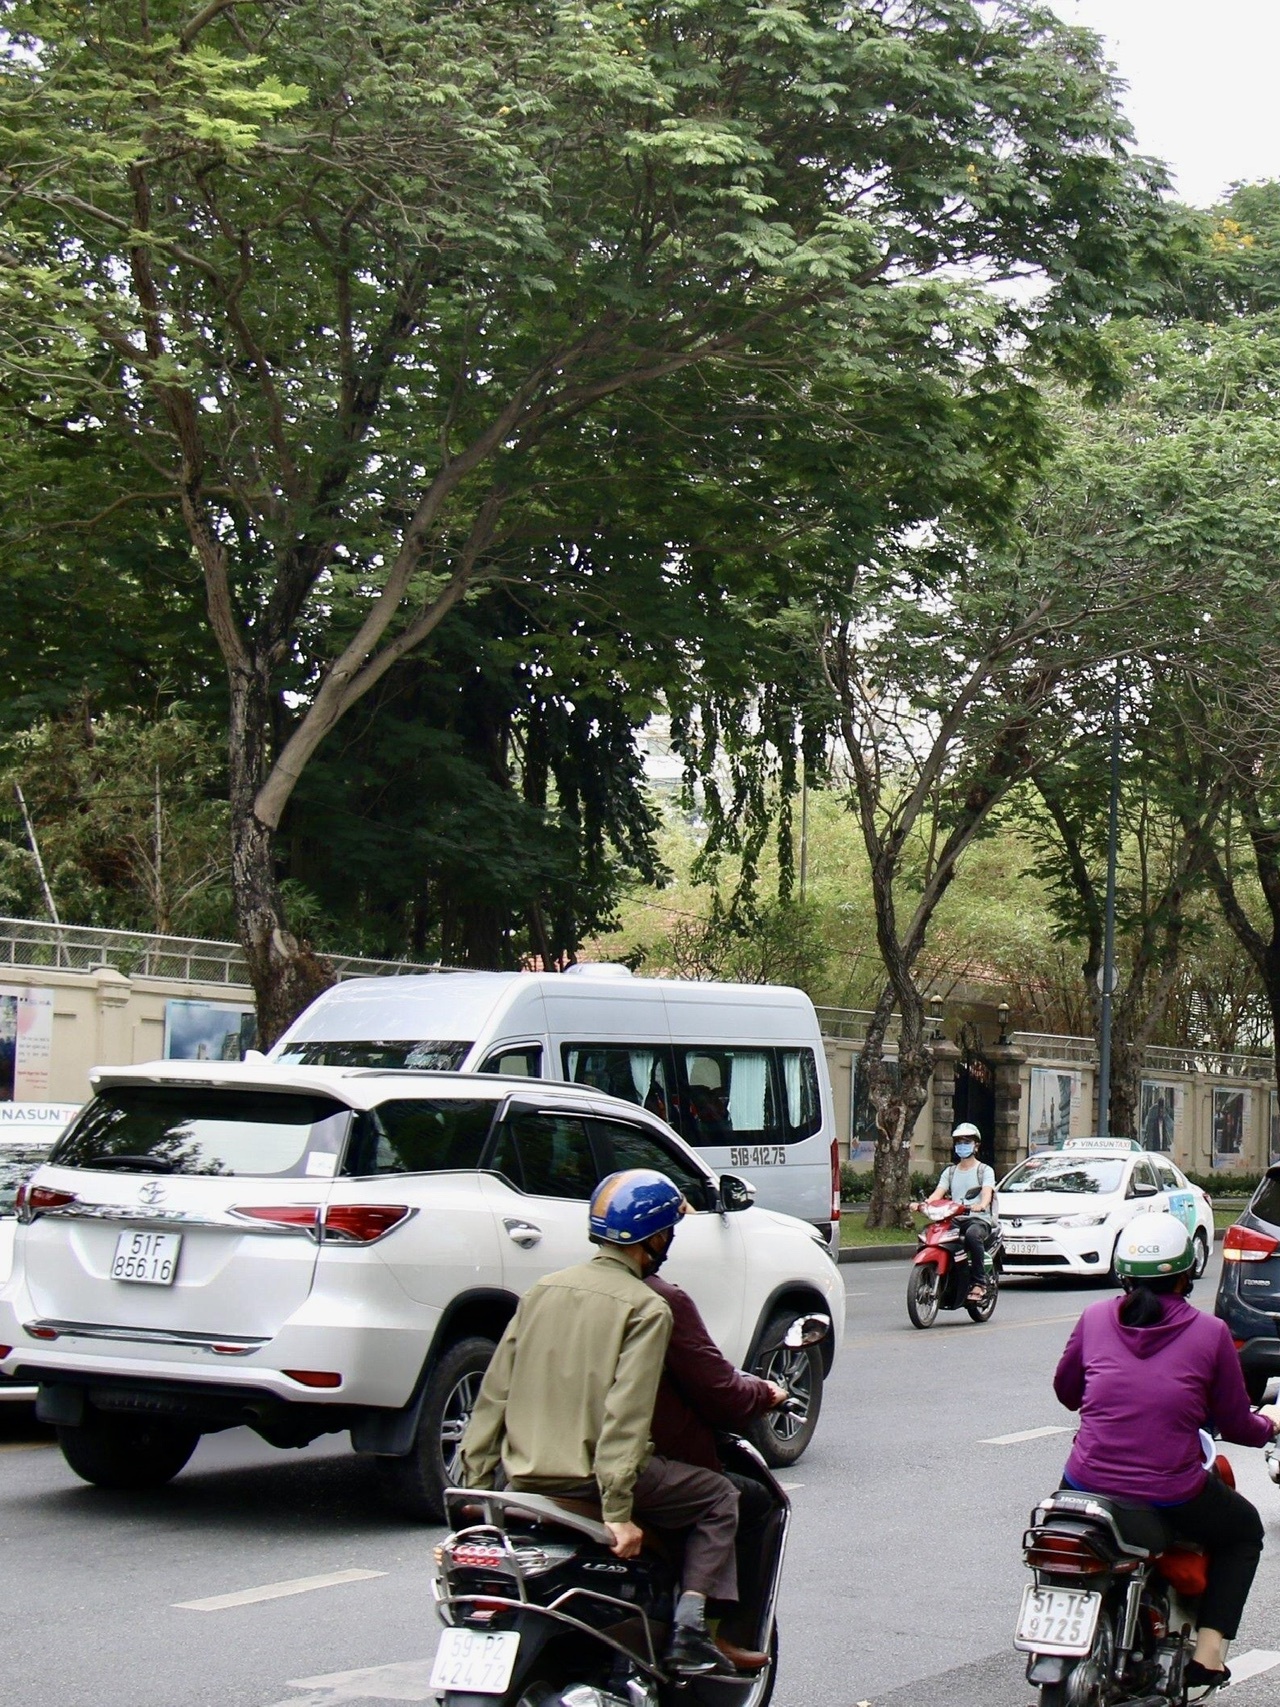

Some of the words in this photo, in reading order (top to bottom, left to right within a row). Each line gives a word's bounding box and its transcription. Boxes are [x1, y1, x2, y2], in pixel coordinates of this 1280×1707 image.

[131, 1234, 166, 1256] 51F
[1137, 1245, 1160, 1254] OCB
[114, 1256, 172, 1281] 856.16
[581, 1562, 629, 1573] LEAD
[1028, 1617, 1082, 1642] 9725
